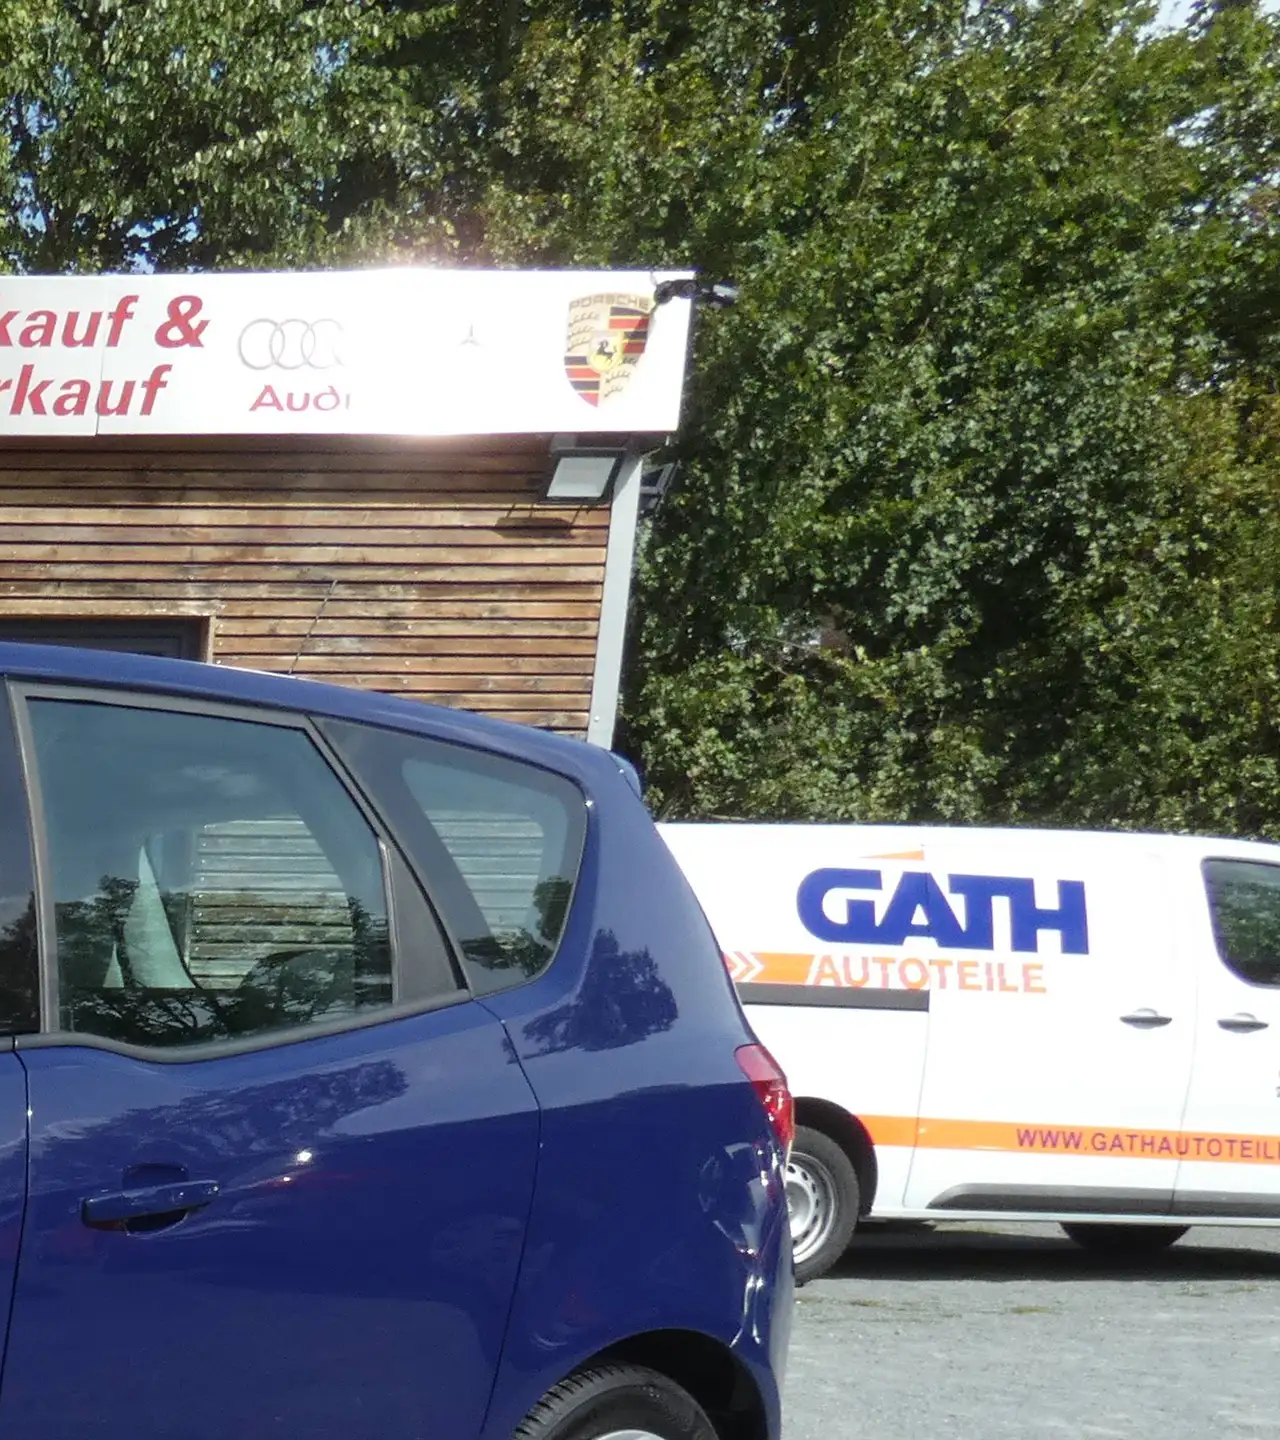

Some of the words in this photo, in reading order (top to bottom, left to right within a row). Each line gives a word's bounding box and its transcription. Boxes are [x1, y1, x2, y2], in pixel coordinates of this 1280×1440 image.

[154, 294, 209, 349] &
[568, 293, 650, 312] PORSCHE
[248, 384, 351, 412] Audi
[797, 867, 1089, 955] GATH
[812, 954, 1048, 994] AUTOTEILE
